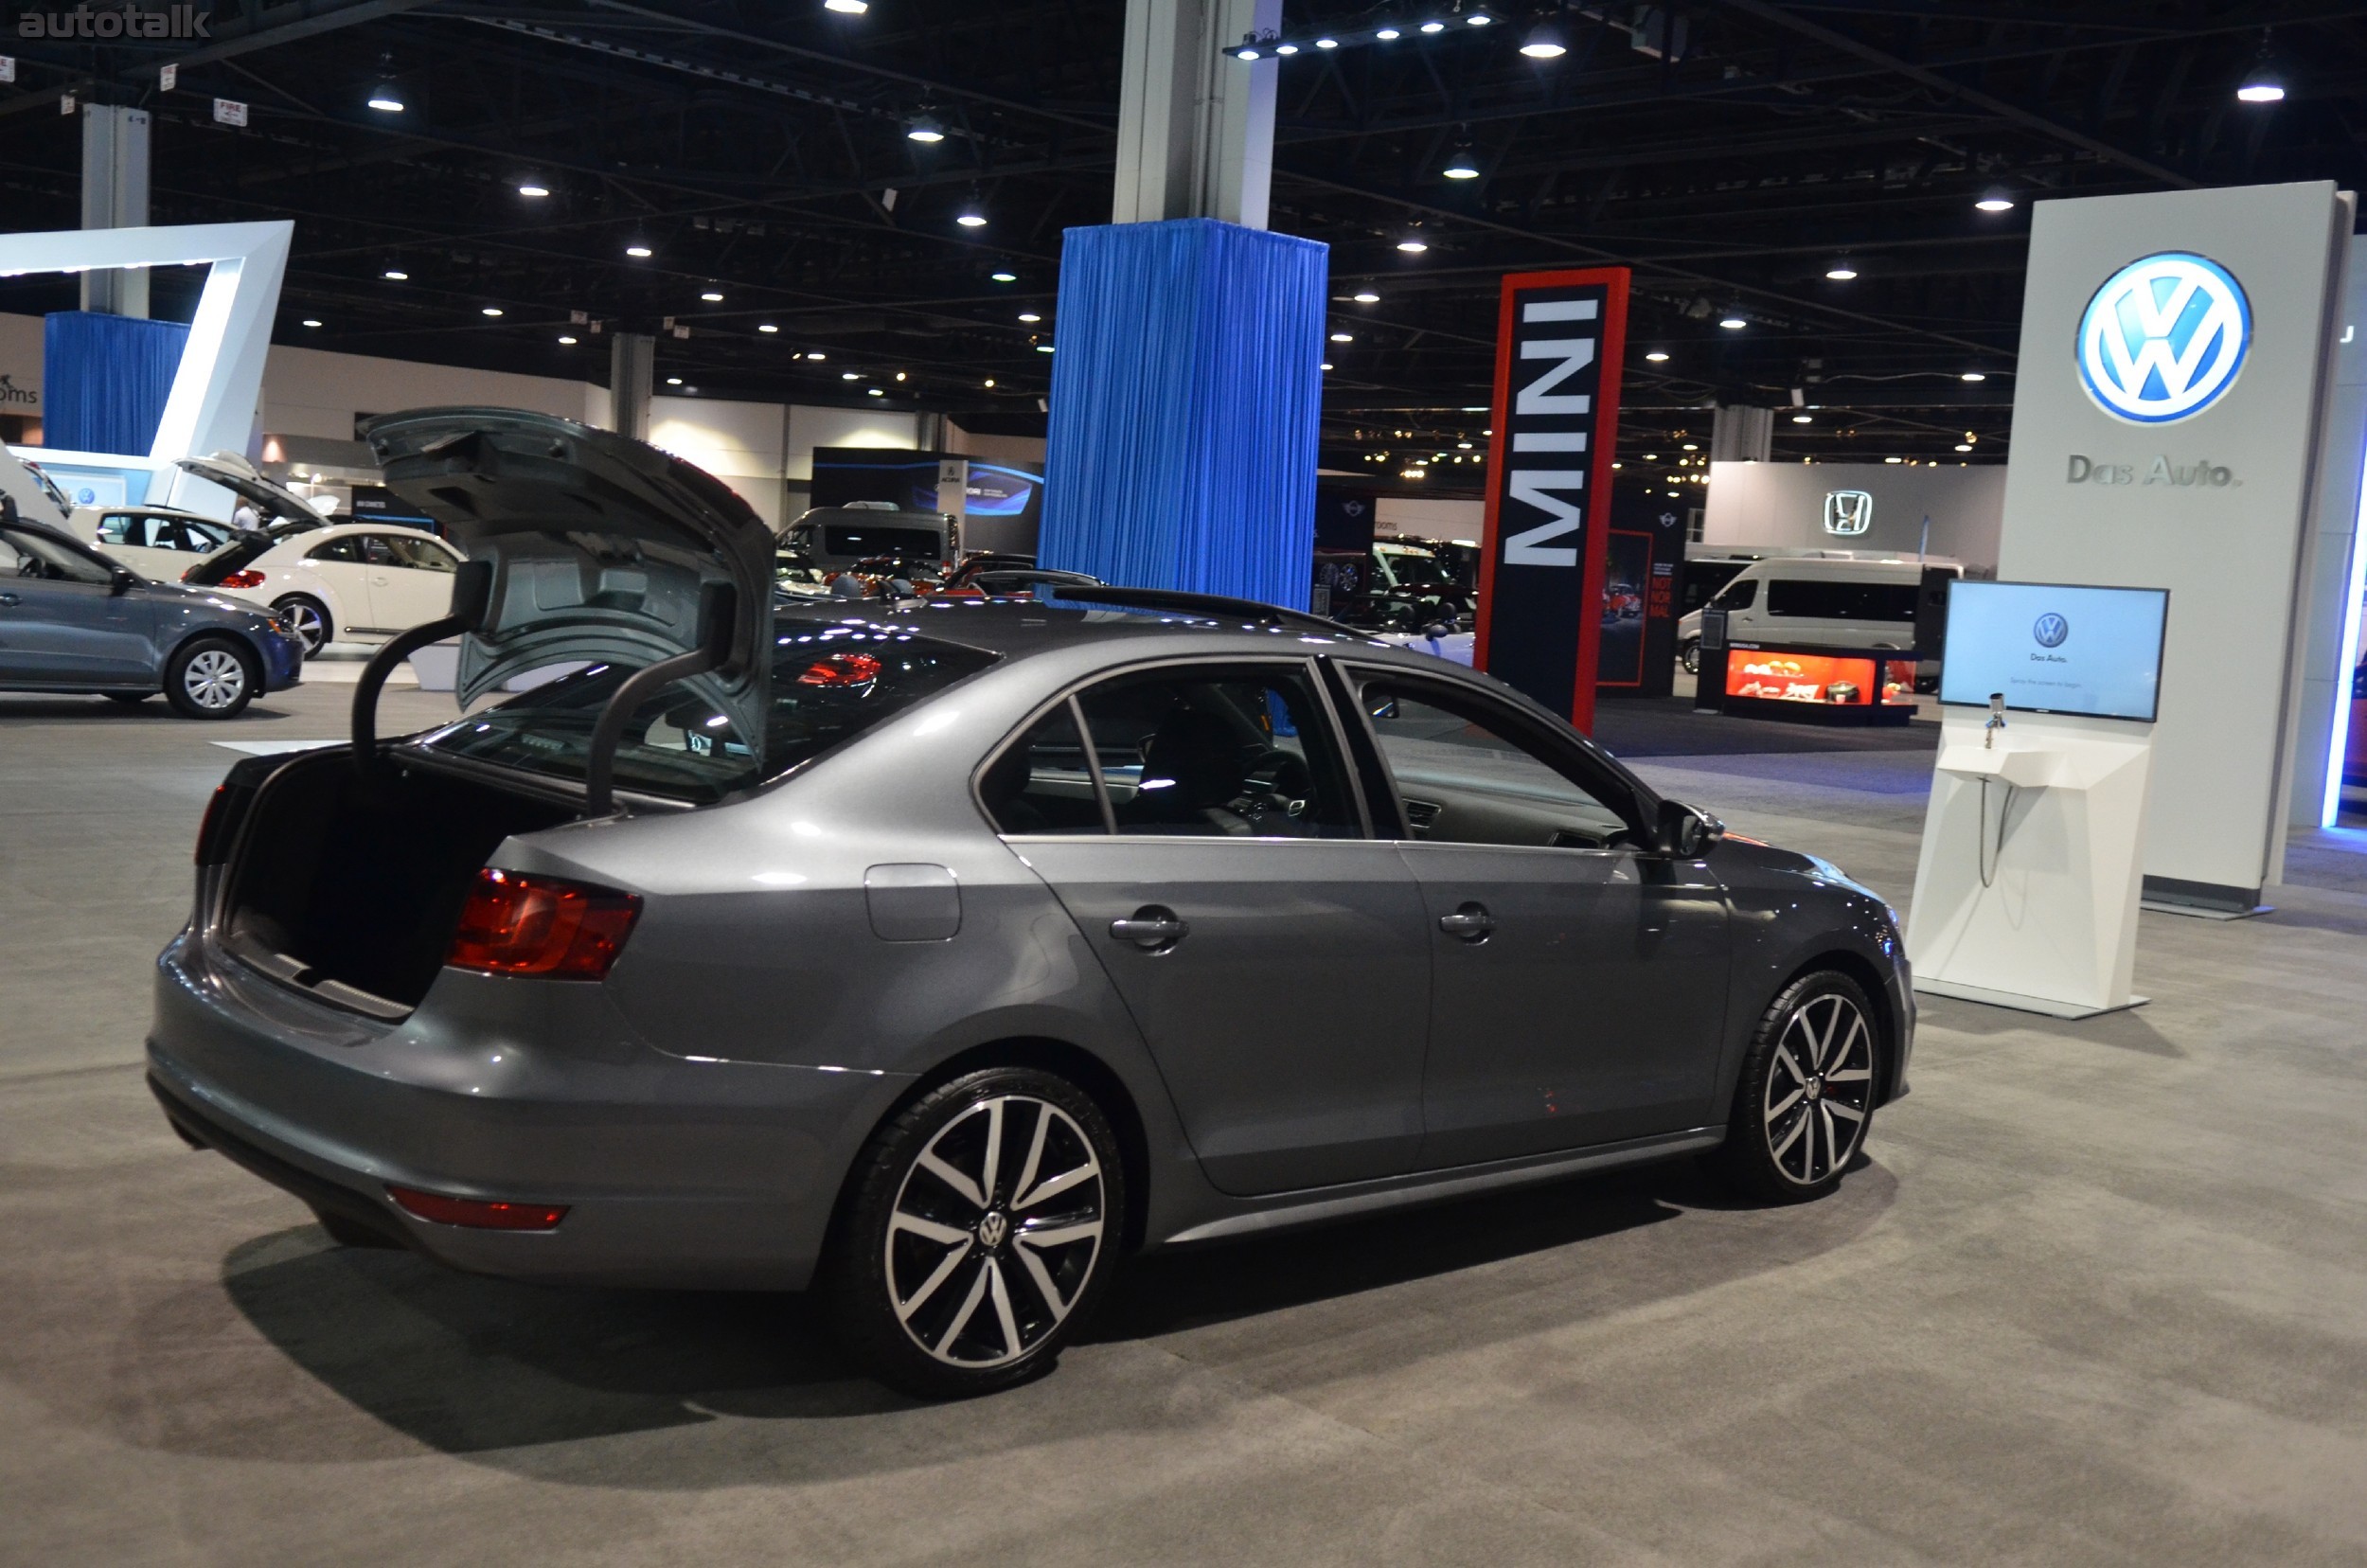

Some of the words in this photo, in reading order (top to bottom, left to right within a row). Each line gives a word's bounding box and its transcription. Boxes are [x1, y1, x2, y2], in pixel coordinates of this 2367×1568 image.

[220, 102, 241, 113] FIRE
[1504, 299, 1598, 567] MINI
[2067, 454, 2134, 485] Das
[2142, 454, 2243, 488] Auto.
